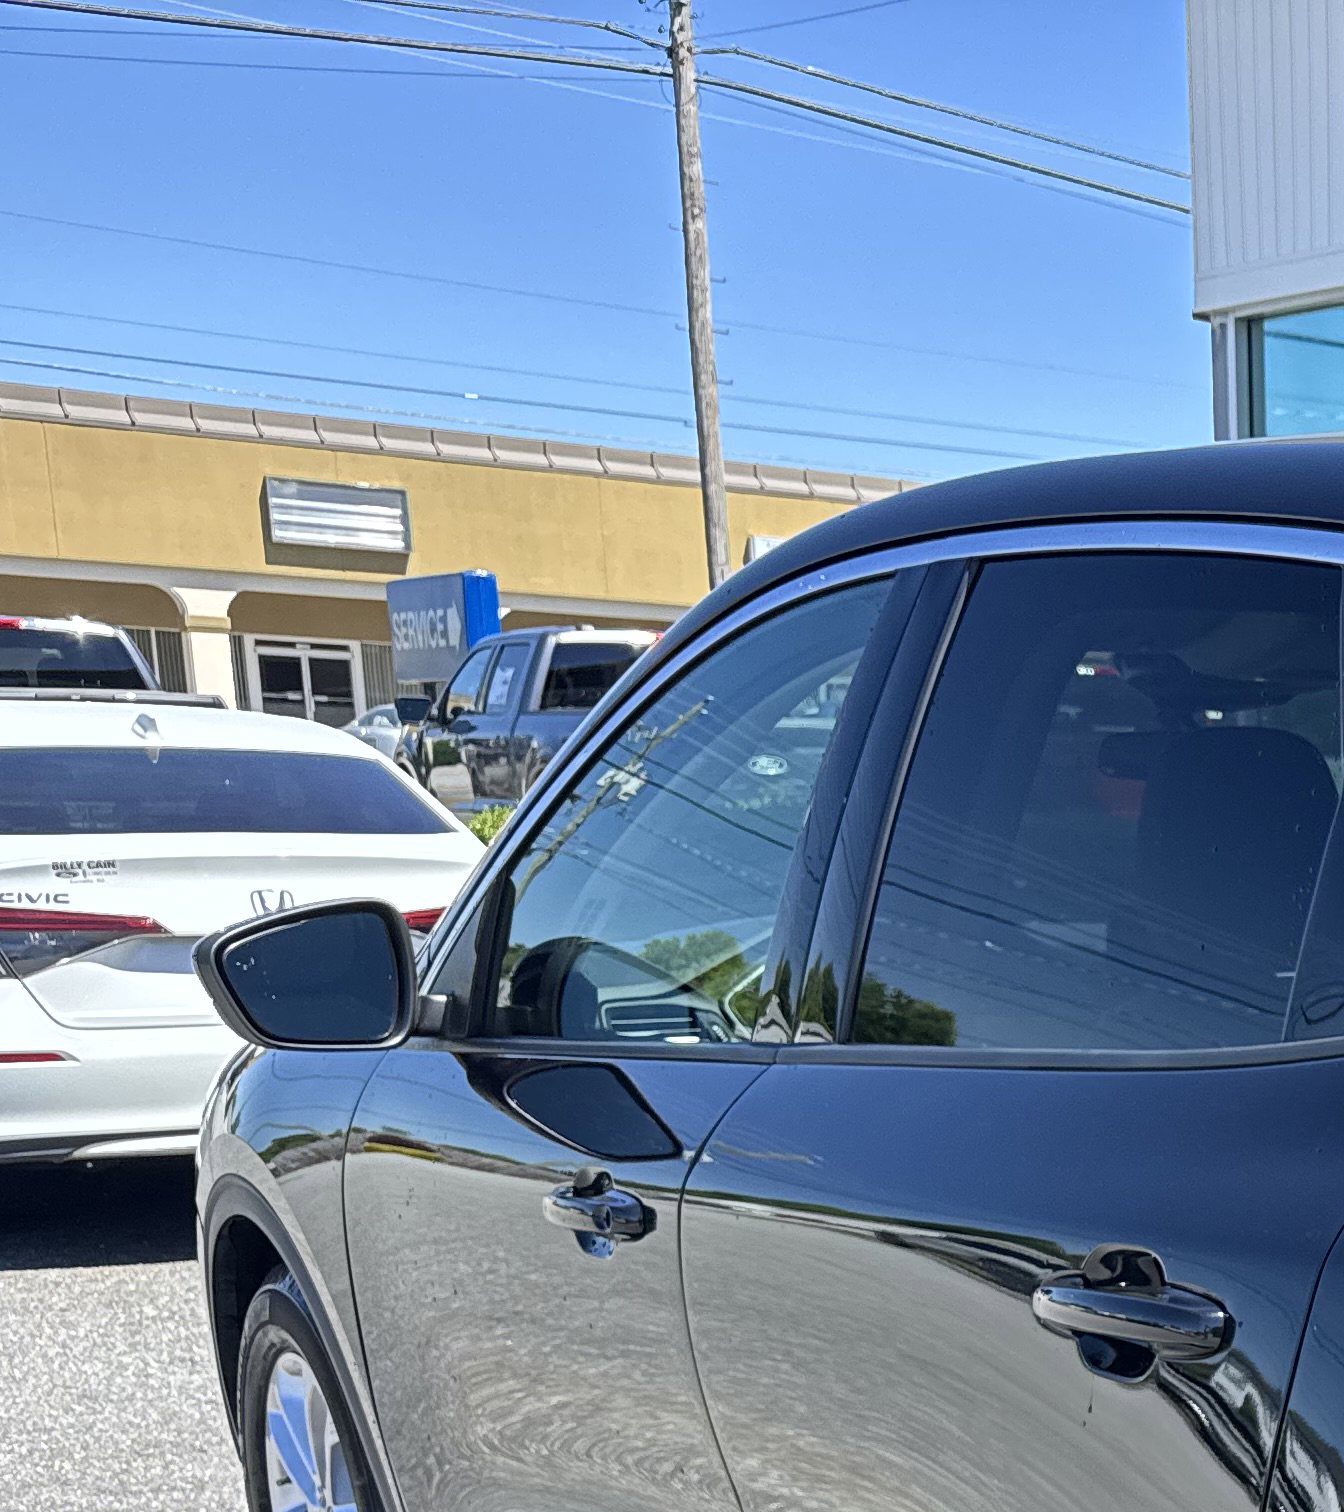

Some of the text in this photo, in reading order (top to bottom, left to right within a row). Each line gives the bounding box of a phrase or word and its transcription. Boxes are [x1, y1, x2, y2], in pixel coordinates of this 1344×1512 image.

[392, 607, 447, 652] SERVICE
[52, 859, 117, 871] BILLY CAIN
[0, 892, 70, 904] CIVIC
